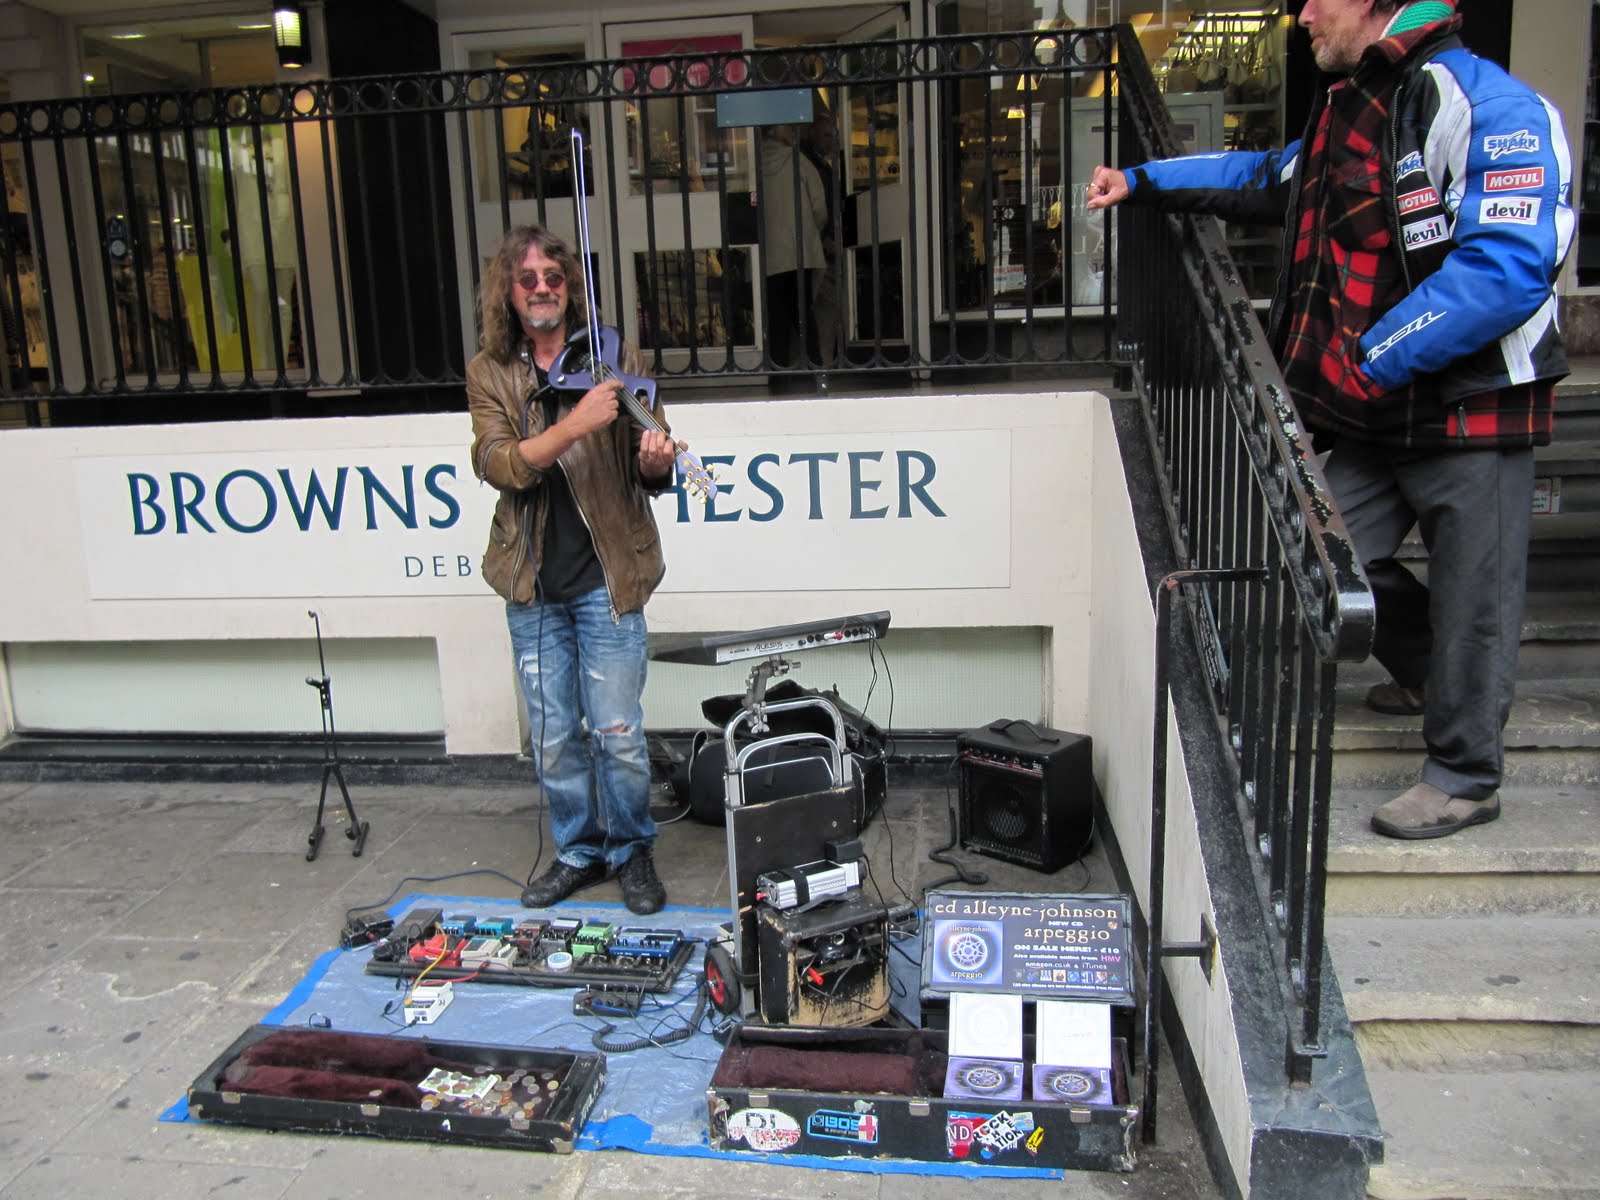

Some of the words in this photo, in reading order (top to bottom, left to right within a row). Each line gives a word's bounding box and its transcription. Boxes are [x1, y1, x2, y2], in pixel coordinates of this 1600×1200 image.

[1487, 136, 1538, 150] SHARK
[1489, 173, 1540, 187] MOTUL
[1486, 201, 1533, 218] devil
[1405, 222, 1442, 245] devil
[126, 463, 461, 535] BROWNS
[657, 450, 948, 523] HESTER
[404, 555, 473, 577] DEB
[934, 900, 956, 914] ed
[963, 900, 1118, 922] alleyne-johnson
[1024, 925, 1110, 944] arpeggio
[1032, 944, 1058, 952] SALE
[1060, 945, 1092, 953] HERE!
[1082, 962, 1107, 970] iTunes
[951, 970, 983, 980] arpeggio
[824, 1115, 860, 1131] BOS
[973, 1112, 1009, 1141] ROCK
[996, 1129, 1024, 1147] TION
